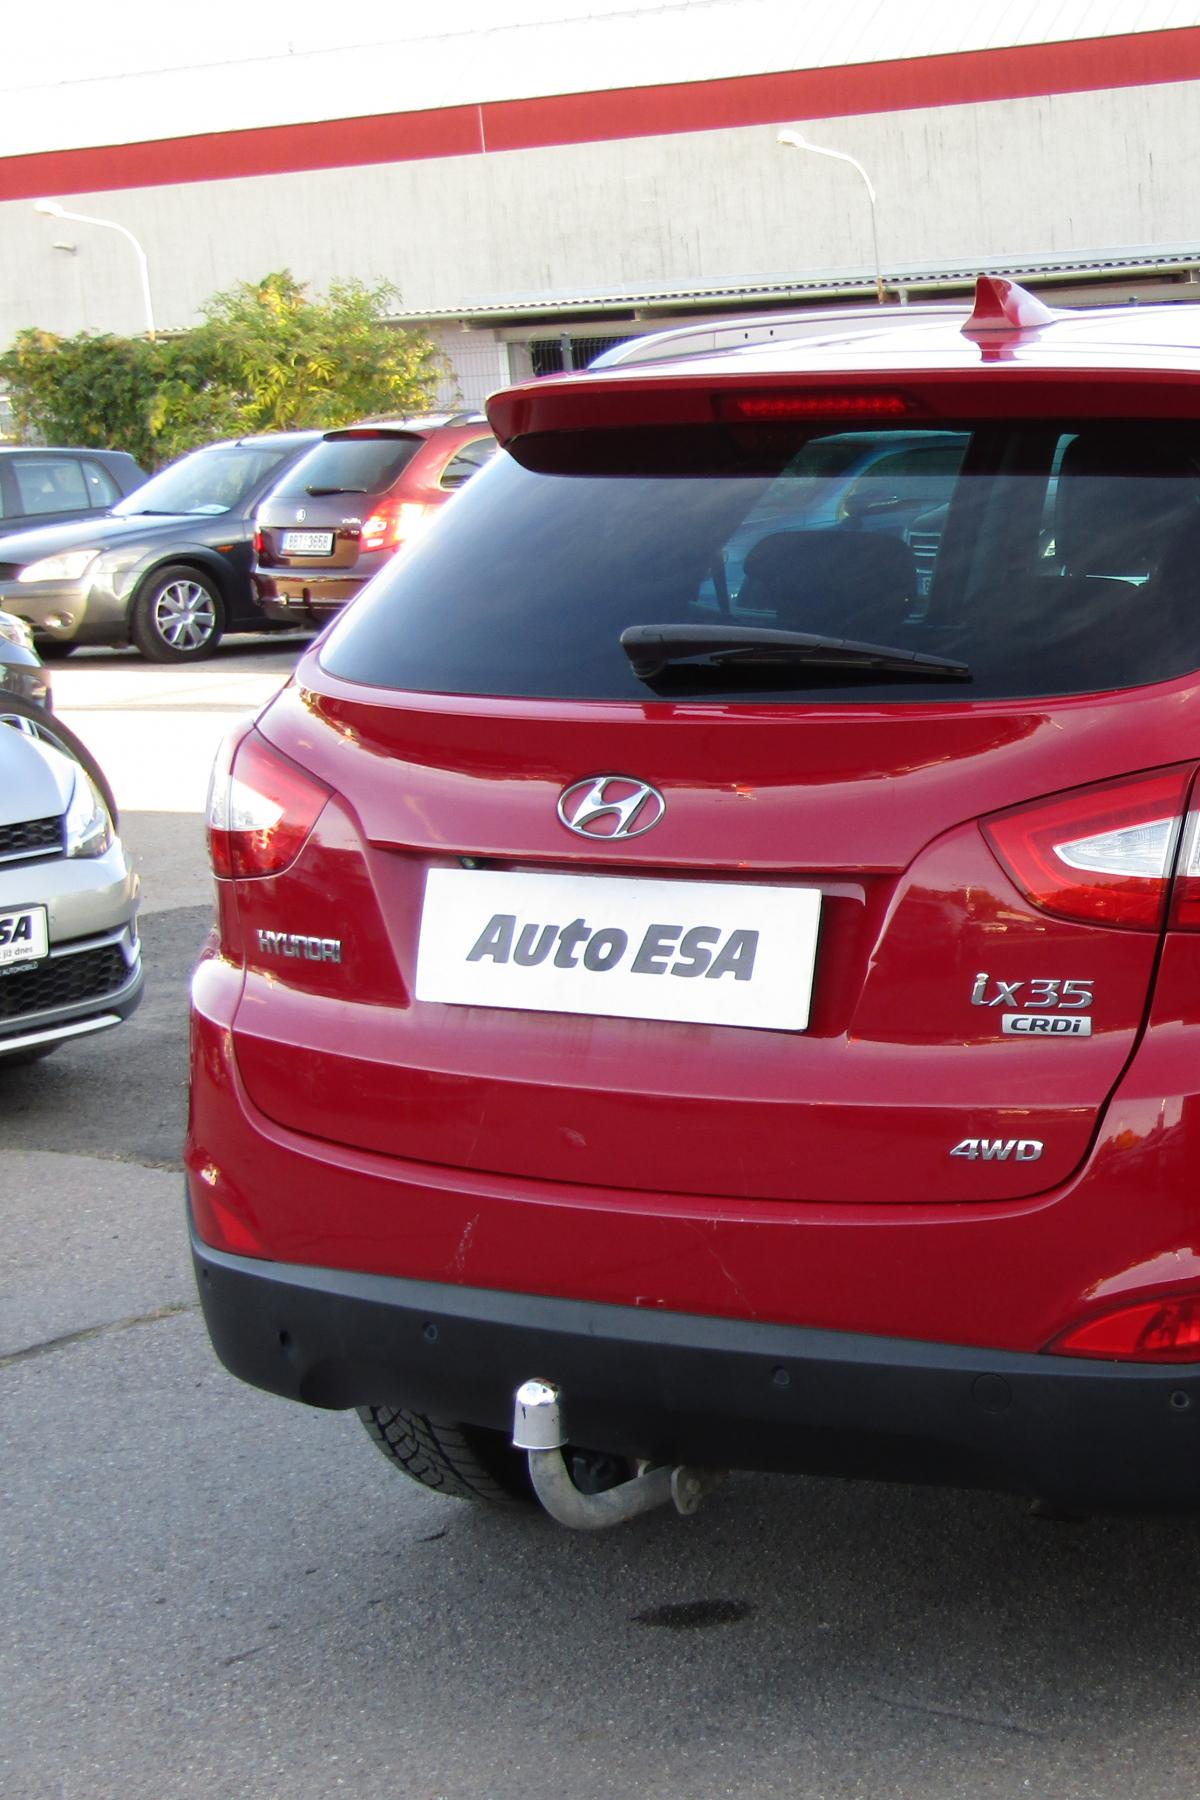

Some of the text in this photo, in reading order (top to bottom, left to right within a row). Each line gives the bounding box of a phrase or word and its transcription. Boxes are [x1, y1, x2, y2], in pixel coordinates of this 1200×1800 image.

[14, 946, 33, 956] dnes
[257, 928, 342, 964] HYUNDAI
[466, 913, 760, 982] Auto ESA
[970, 972, 1095, 1009] ix35
[1010, 1017, 1082, 1034] CRDi
[949, 1138, 1045, 1162] 4WD
